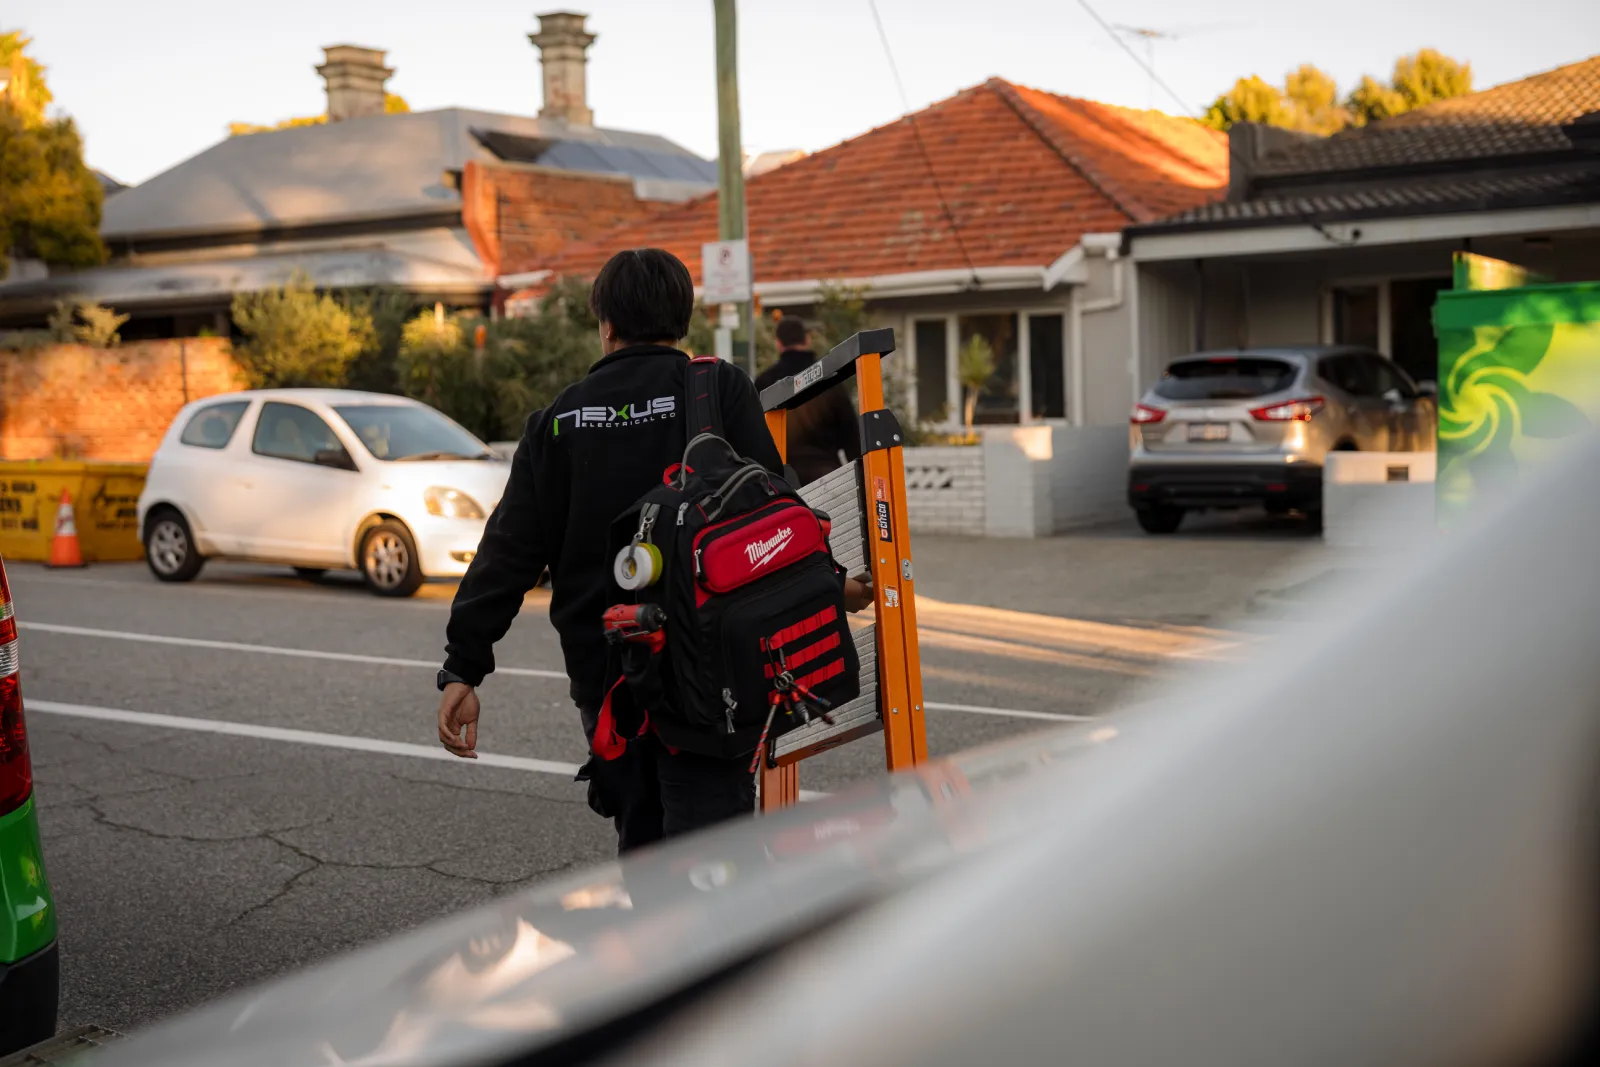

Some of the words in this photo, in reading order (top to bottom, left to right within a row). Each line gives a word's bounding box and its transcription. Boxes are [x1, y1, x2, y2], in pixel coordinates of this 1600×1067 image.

[553, 396, 675, 436] NEXUS
[581, 416, 655, 428] ELECTRICAL
[878, 503, 888, 529] CITECO
[744, 527, 792, 564] Milwaukee
